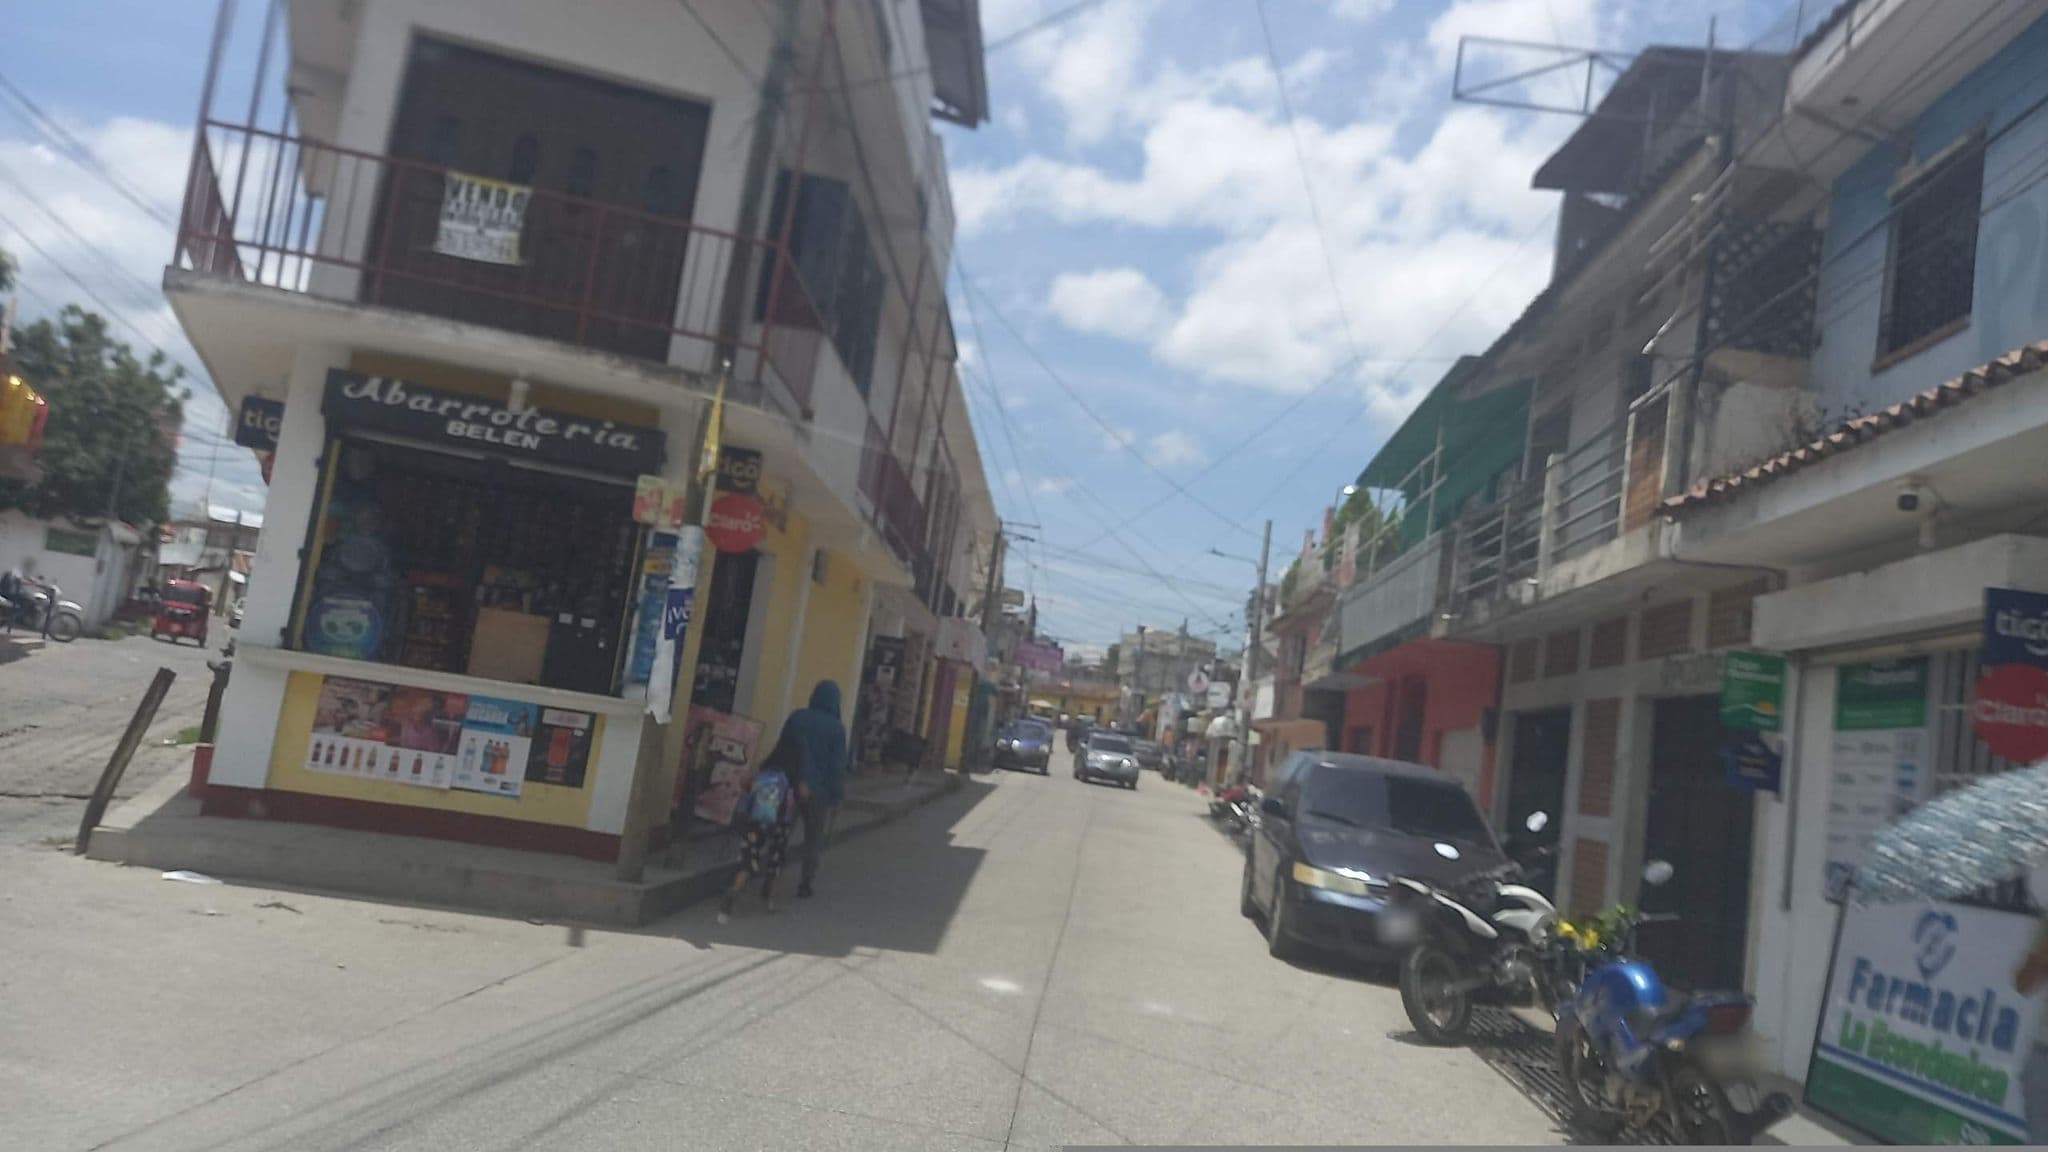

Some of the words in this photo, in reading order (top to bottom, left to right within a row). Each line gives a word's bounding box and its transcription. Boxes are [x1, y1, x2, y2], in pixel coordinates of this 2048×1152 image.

[244, 408, 281, 441] tig
[344, 377, 640, 451] Abarroteria
[446, 420, 540, 450] BELEN
[1848, 956, 2020, 1053] Farmacia
